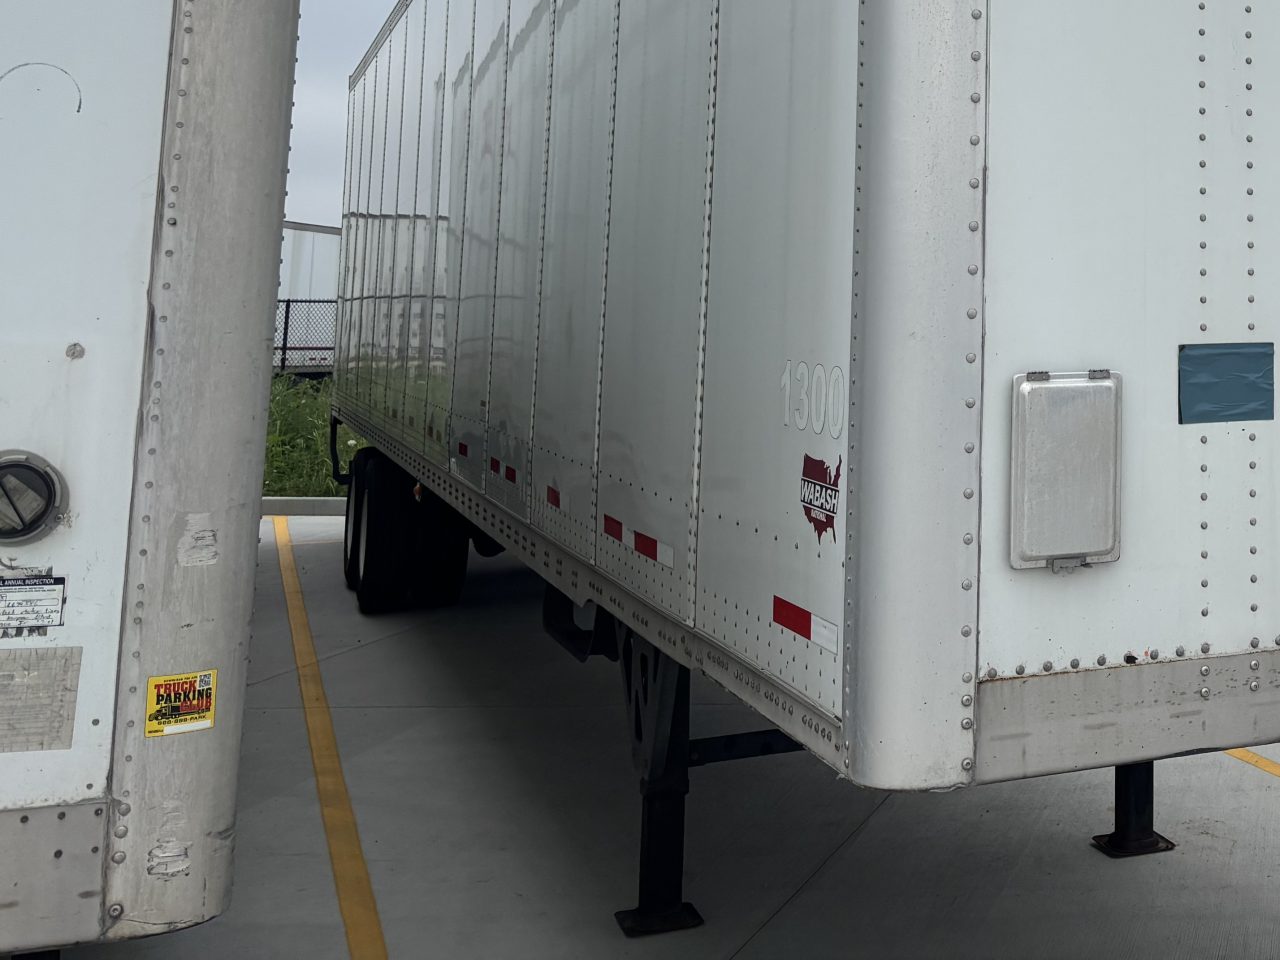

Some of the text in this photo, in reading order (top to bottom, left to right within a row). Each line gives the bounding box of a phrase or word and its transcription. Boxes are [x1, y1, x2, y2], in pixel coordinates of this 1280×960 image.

[780, 359, 845, 440] 1300
[801, 479, 839, 513] WABASH
[154, 679, 197, 695] TRUCK
[156, 687, 212, 705] PARKING
[180, 696, 212, 713] CLUB
